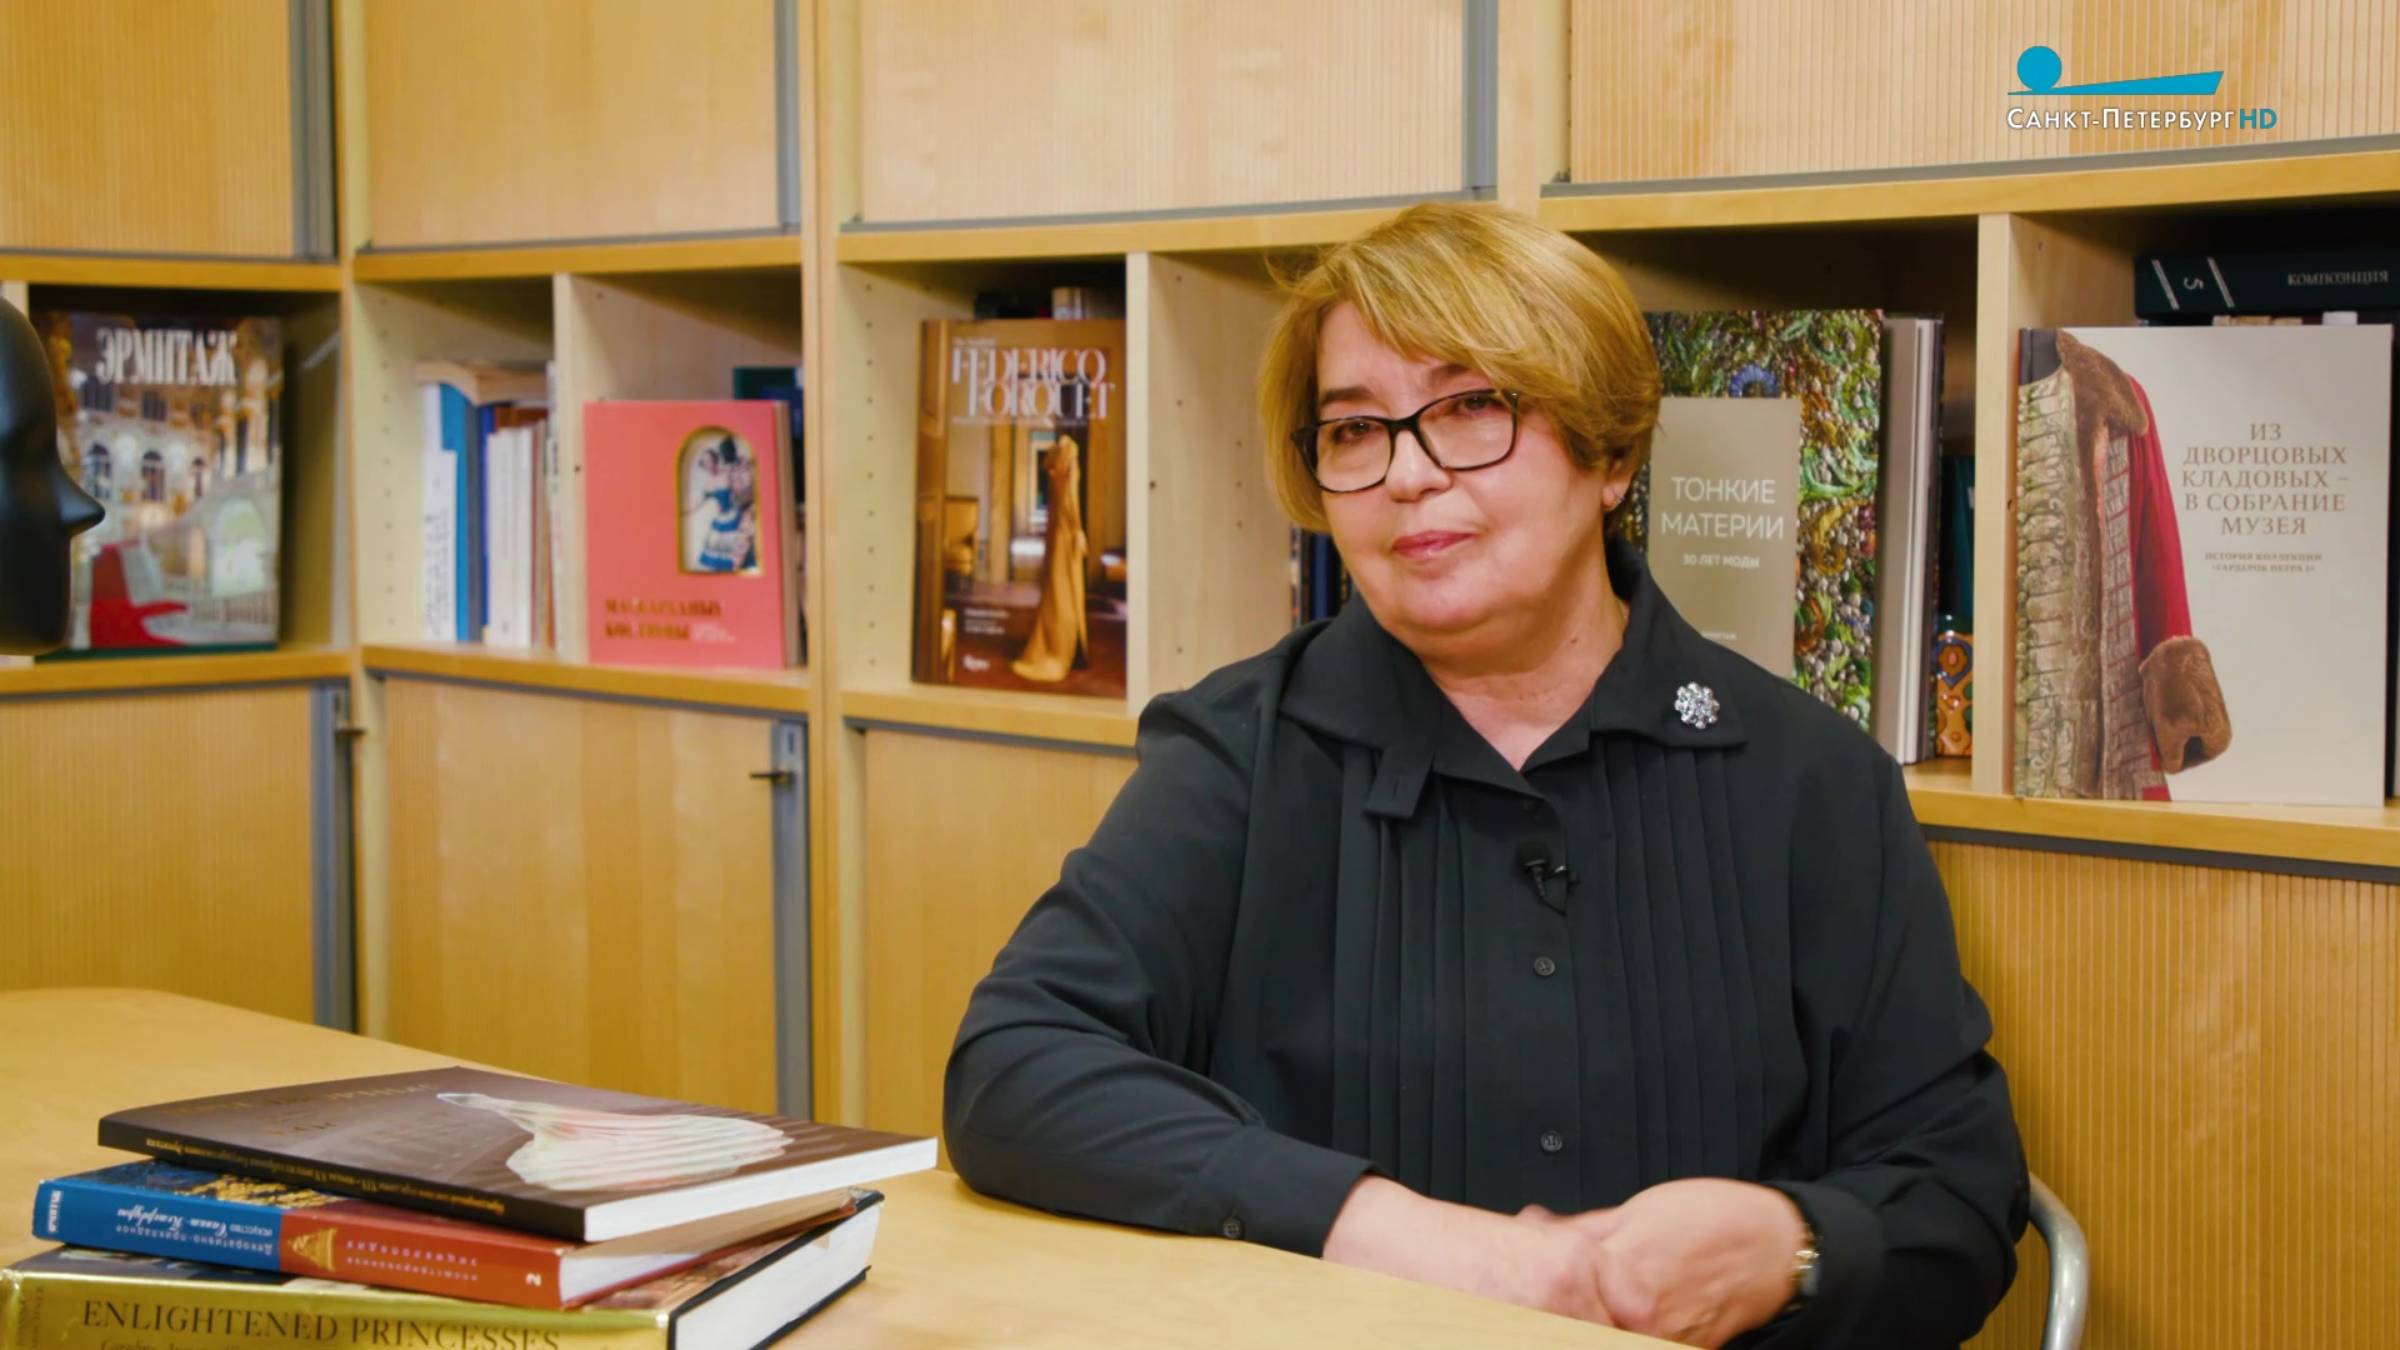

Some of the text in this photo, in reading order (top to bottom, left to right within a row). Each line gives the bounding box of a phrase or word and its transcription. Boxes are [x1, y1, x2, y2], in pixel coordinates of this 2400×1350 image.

[2184, 277, 2204, 290] 5
[2288, 270, 2389, 286] КОМПОЗИЦИЯ
[96, 327, 238, 385] ЭРМИТАЖ
[2249, 423, 2282, 441] ИЗ
[2183, 446, 2348, 466] ДВОРЦОВЫХ
[2182, 470, 2329, 489] КЛАДОВЫХ
[1672, 477, 1776, 504] ТОНКИЕ
[2185, 493, 2346, 512] В СОБРАНИЕ
[1661, 512, 1784, 540] МАТЕРИИ
[2221, 517, 2307, 536] МУЗЕЯ
[1683, 554, 1760, 569] 30 ЛЕТ МОДЫ
[525, 1272, 542, 1286] 2
[83, 1300, 338, 1344] ENLIGHTENED
[352, 1317, 560, 1350] PRINCESSES
